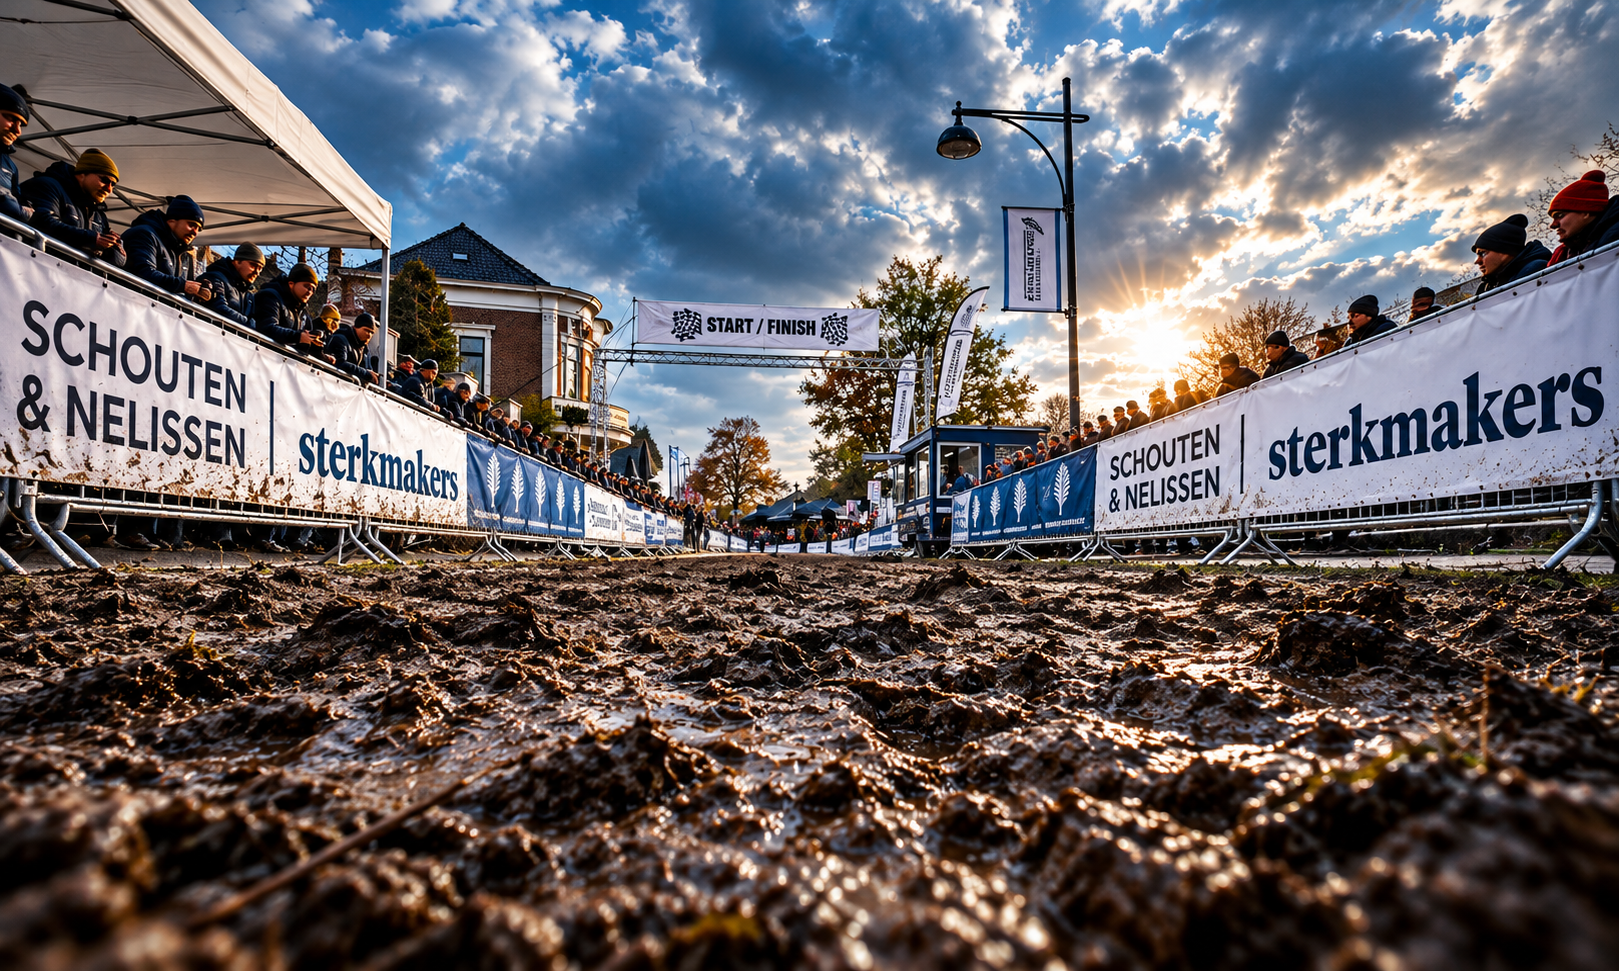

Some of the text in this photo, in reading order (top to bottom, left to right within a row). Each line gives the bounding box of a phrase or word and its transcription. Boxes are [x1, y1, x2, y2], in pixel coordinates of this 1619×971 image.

[21, 300, 246, 414] SCHOUTEN
[707, 317, 816, 336] START / FINISH
[16, 374, 246, 469] & NELISSEN
[1110, 423, 1220, 481] SCHOUTEN
[1268, 366, 1605, 481] sterkmakers
[298, 427, 459, 502] sterkmakers
[1108, 466, 1220, 513] & NELISSEN
